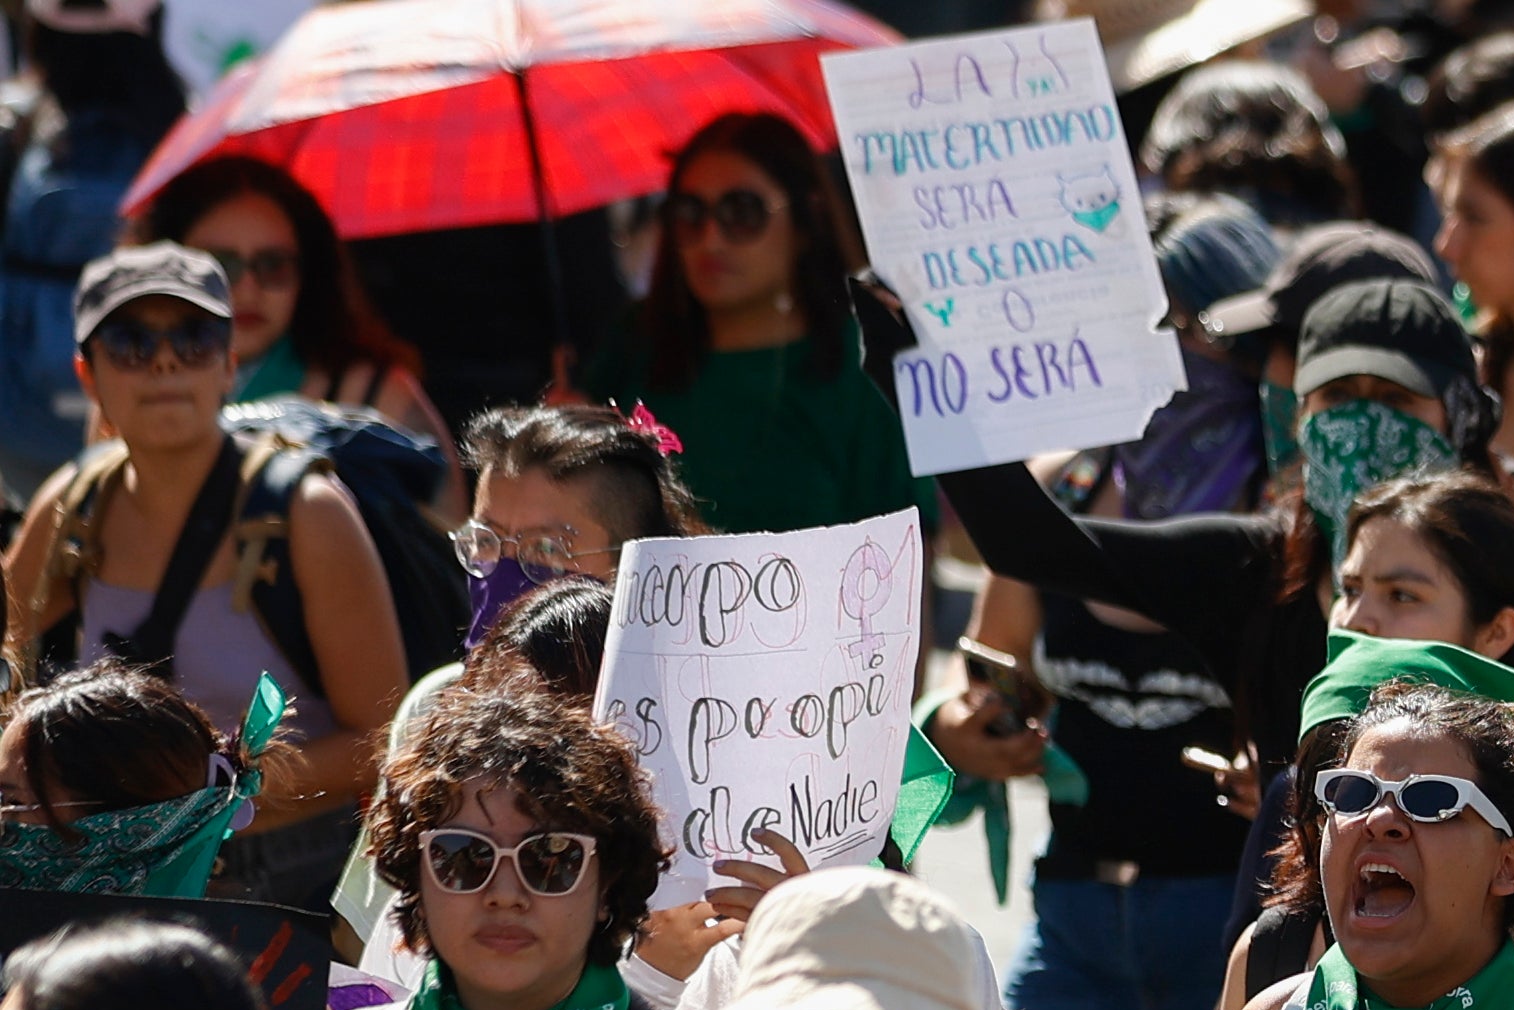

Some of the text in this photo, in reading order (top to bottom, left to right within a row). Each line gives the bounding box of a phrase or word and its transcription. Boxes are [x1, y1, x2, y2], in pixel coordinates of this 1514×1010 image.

[855, 104, 1118, 176] MATERNIDAD
[922, 233, 1097, 292] DESEADA
[1001, 288, 1036, 333] O
[897, 351, 969, 418] NO
